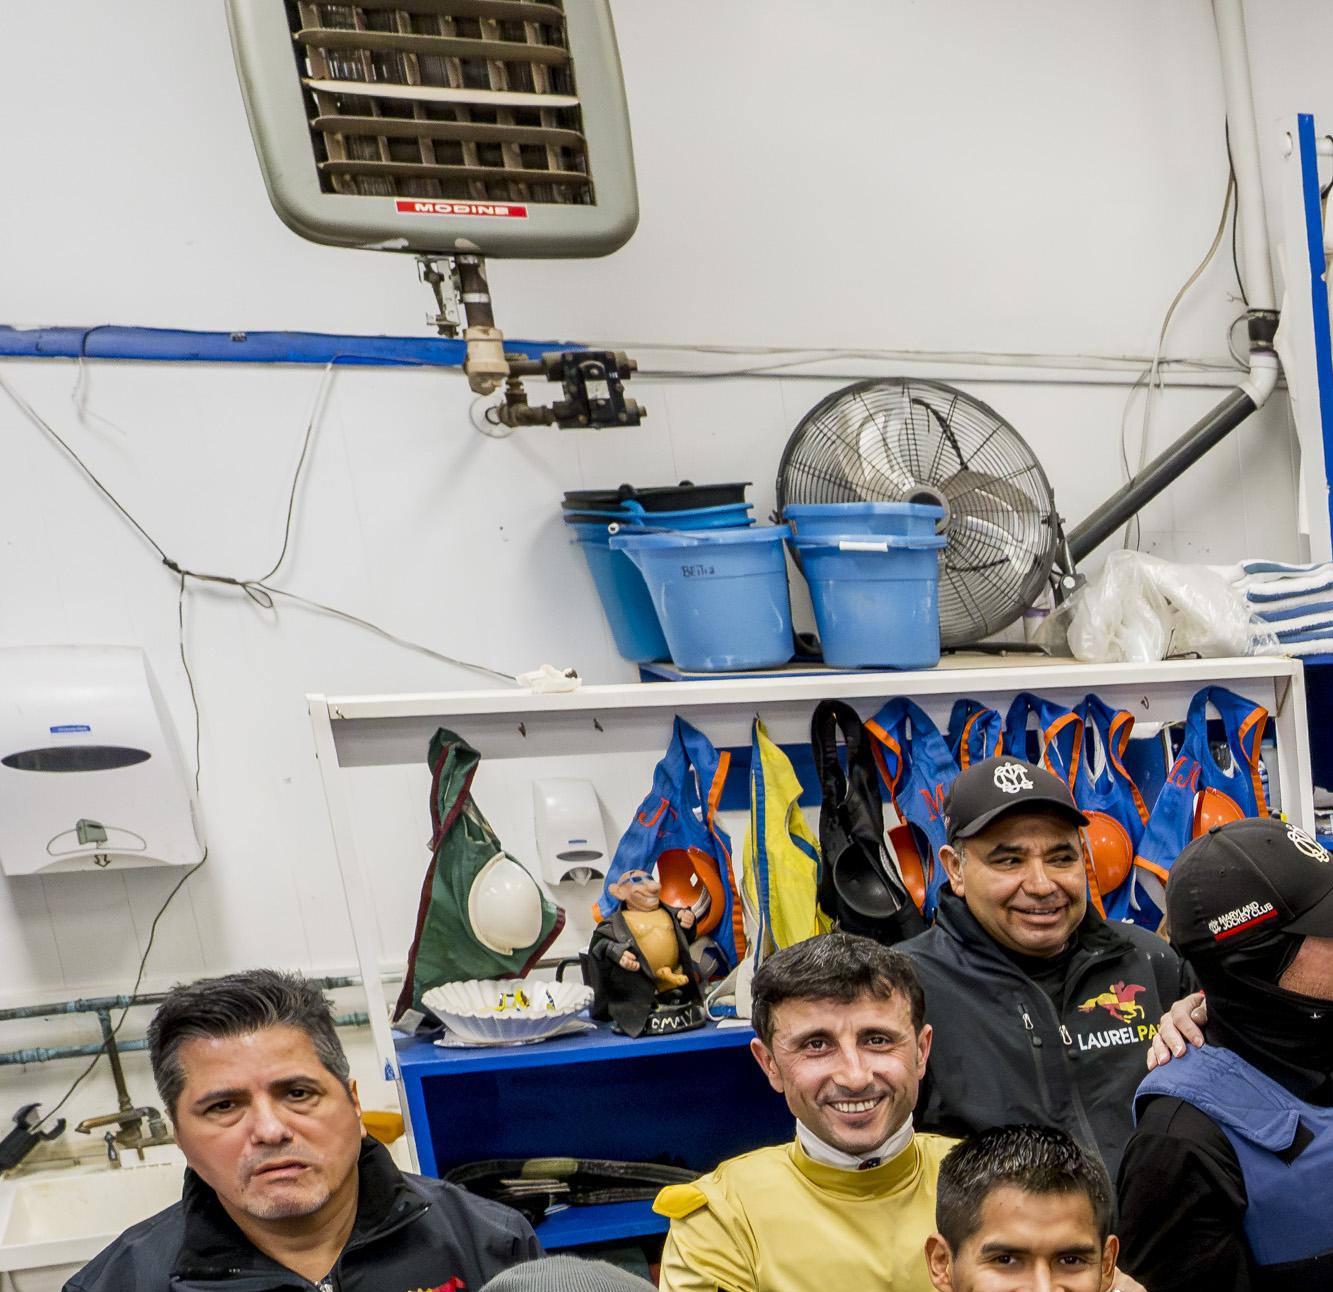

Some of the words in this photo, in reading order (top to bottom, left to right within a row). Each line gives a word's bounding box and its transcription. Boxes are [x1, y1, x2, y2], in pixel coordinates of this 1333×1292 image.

[415, 203, 509, 216] MODINE
[1218, 901, 1259, 925] MARYLAND
[1222, 908, 1252, 930] JOCKEY
[1251, 902, 1274, 918] CLUB
[1077, 1025, 1161, 1051] LAURELPA
